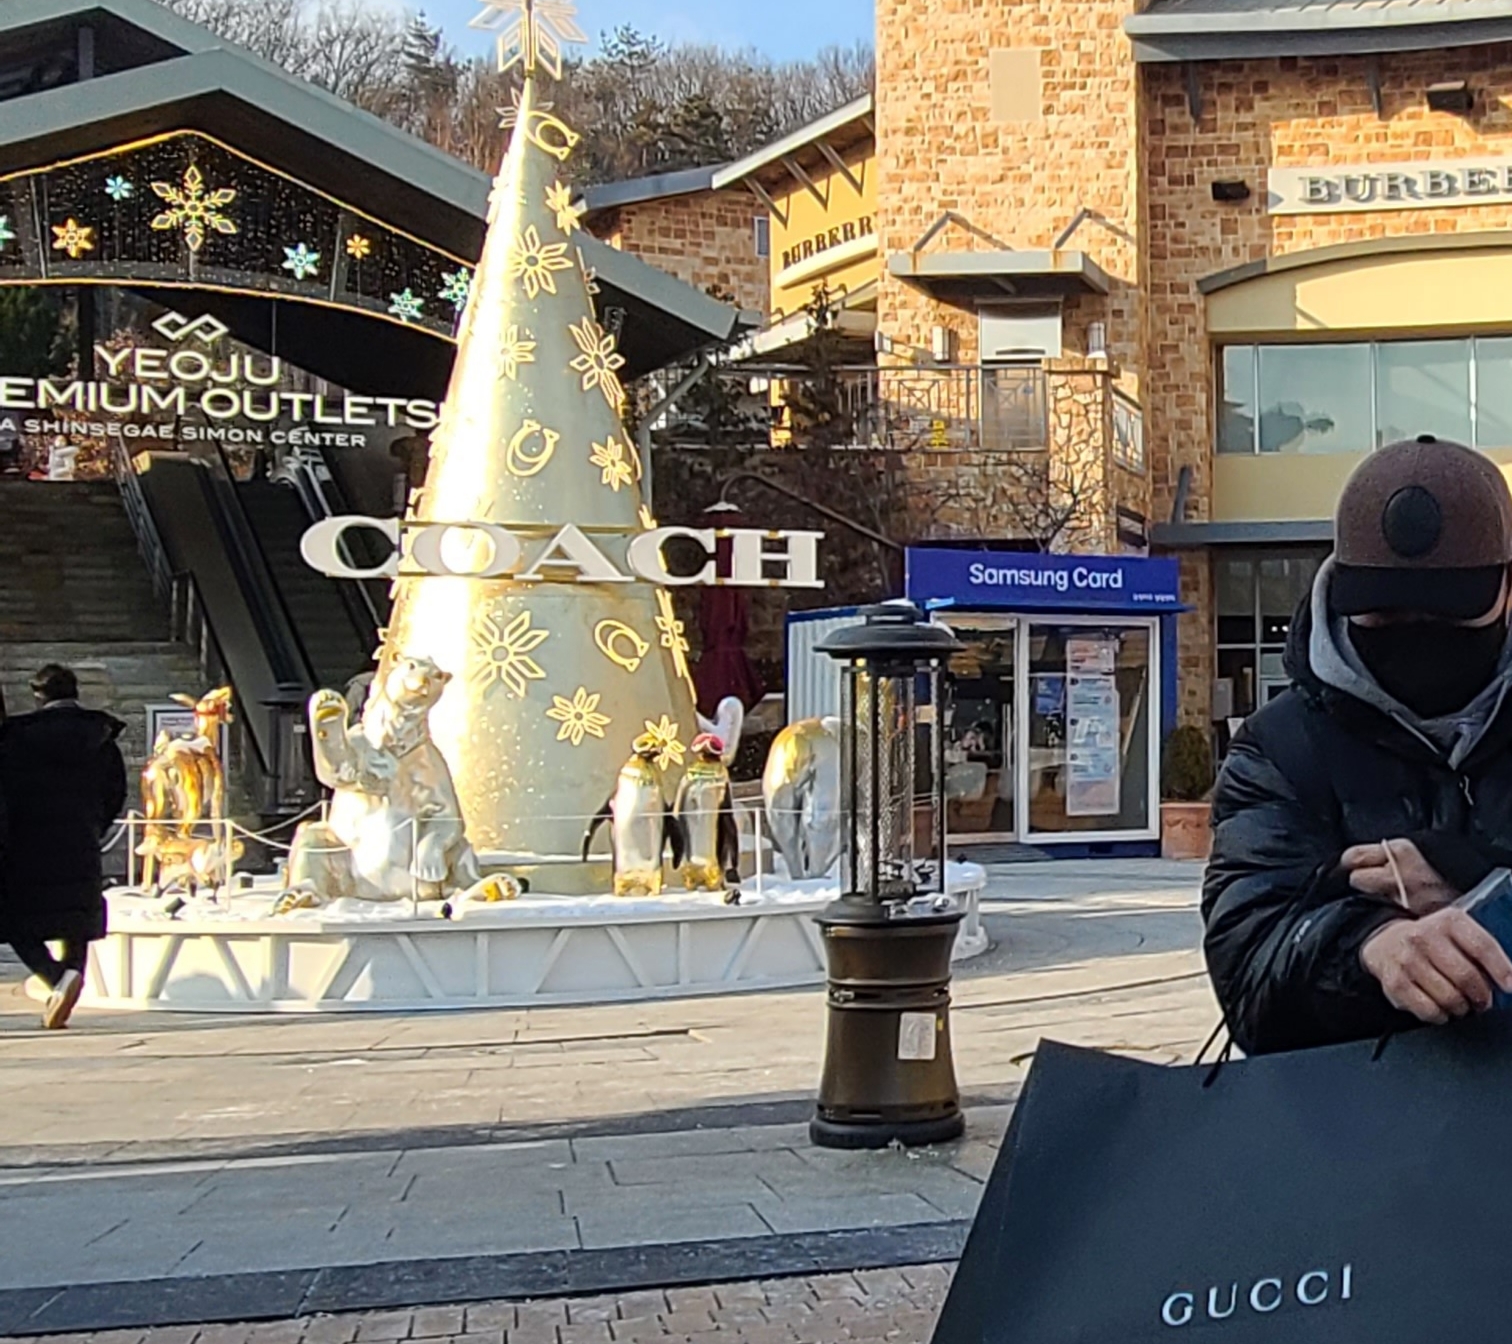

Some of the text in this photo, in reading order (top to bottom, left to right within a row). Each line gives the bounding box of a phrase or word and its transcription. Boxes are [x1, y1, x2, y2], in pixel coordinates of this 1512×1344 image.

[782, 210, 878, 270] BURBERR
[93, 344, 281, 386] YEOJU
[200, 387, 437, 429] OUTLETS
[23, 418, 175, 439] SHINSEGAE
[182, 425, 264, 444] SIMON
[271, 429, 367, 449] CENTER
[300, 515, 826, 588] COACH
[969, 562, 1123, 592] Samsung Card
[1161, 1262, 1352, 1327] GUCCI
